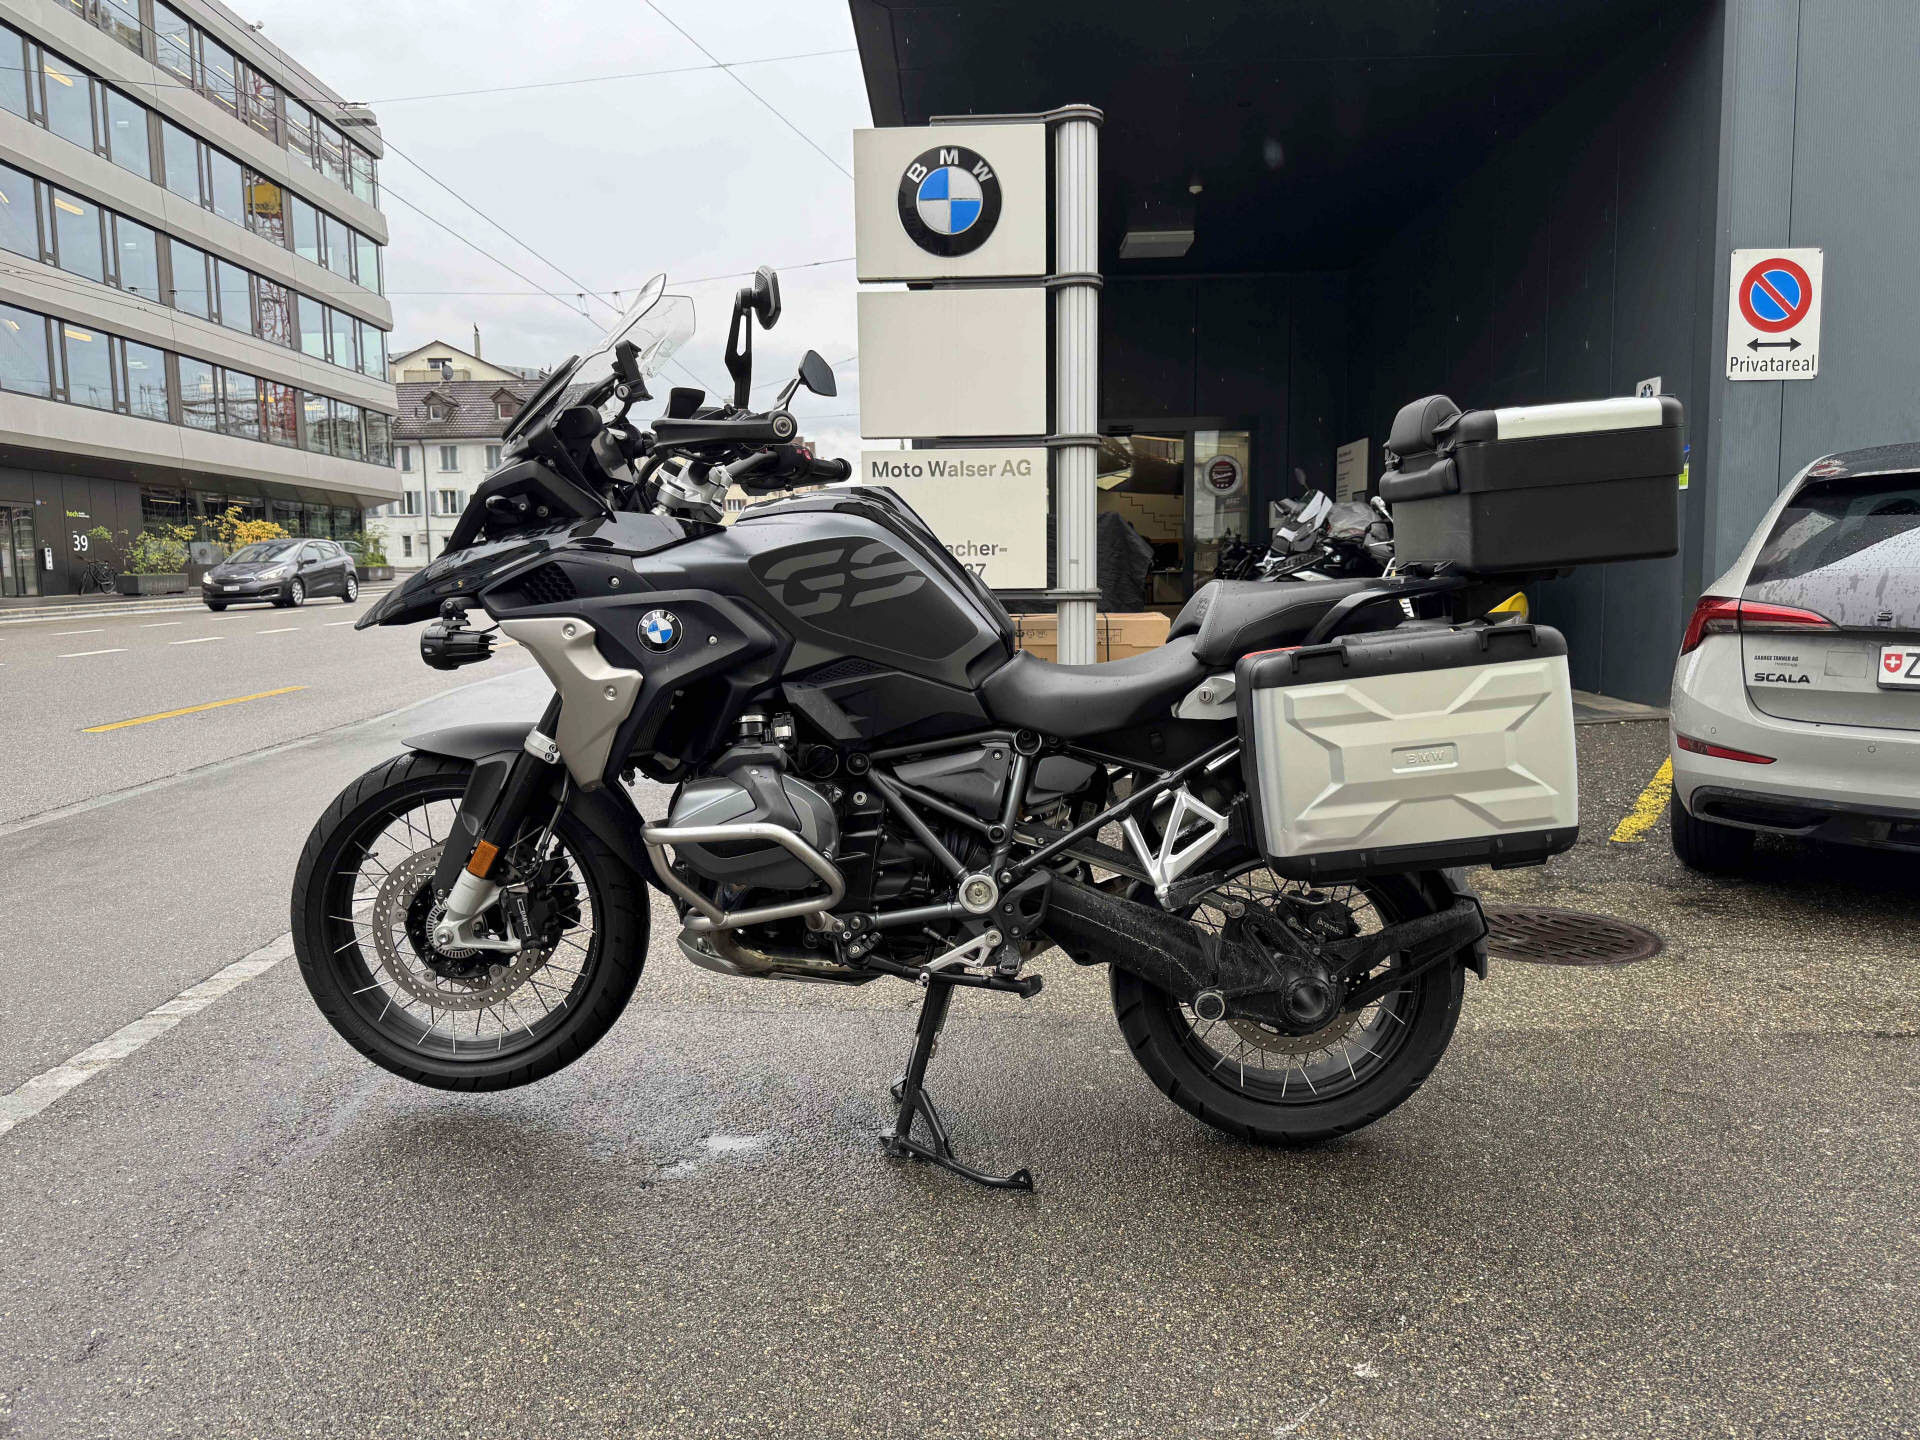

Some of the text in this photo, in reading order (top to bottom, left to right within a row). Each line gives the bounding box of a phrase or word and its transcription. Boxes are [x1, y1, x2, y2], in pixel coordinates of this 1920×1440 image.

[907, 148, 993, 183] BMW
[1730, 354, 1815, 372] Privatareal
[872, 459, 1032, 478] Moto Walser AG
[73, 535, 88, 551] 39
[640, 611, 676, 627] BMW
[1753, 672, 1810, 684] SCALA
[1405, 750, 1445, 764] BMW
[1316, 916, 1344, 935] brembo
